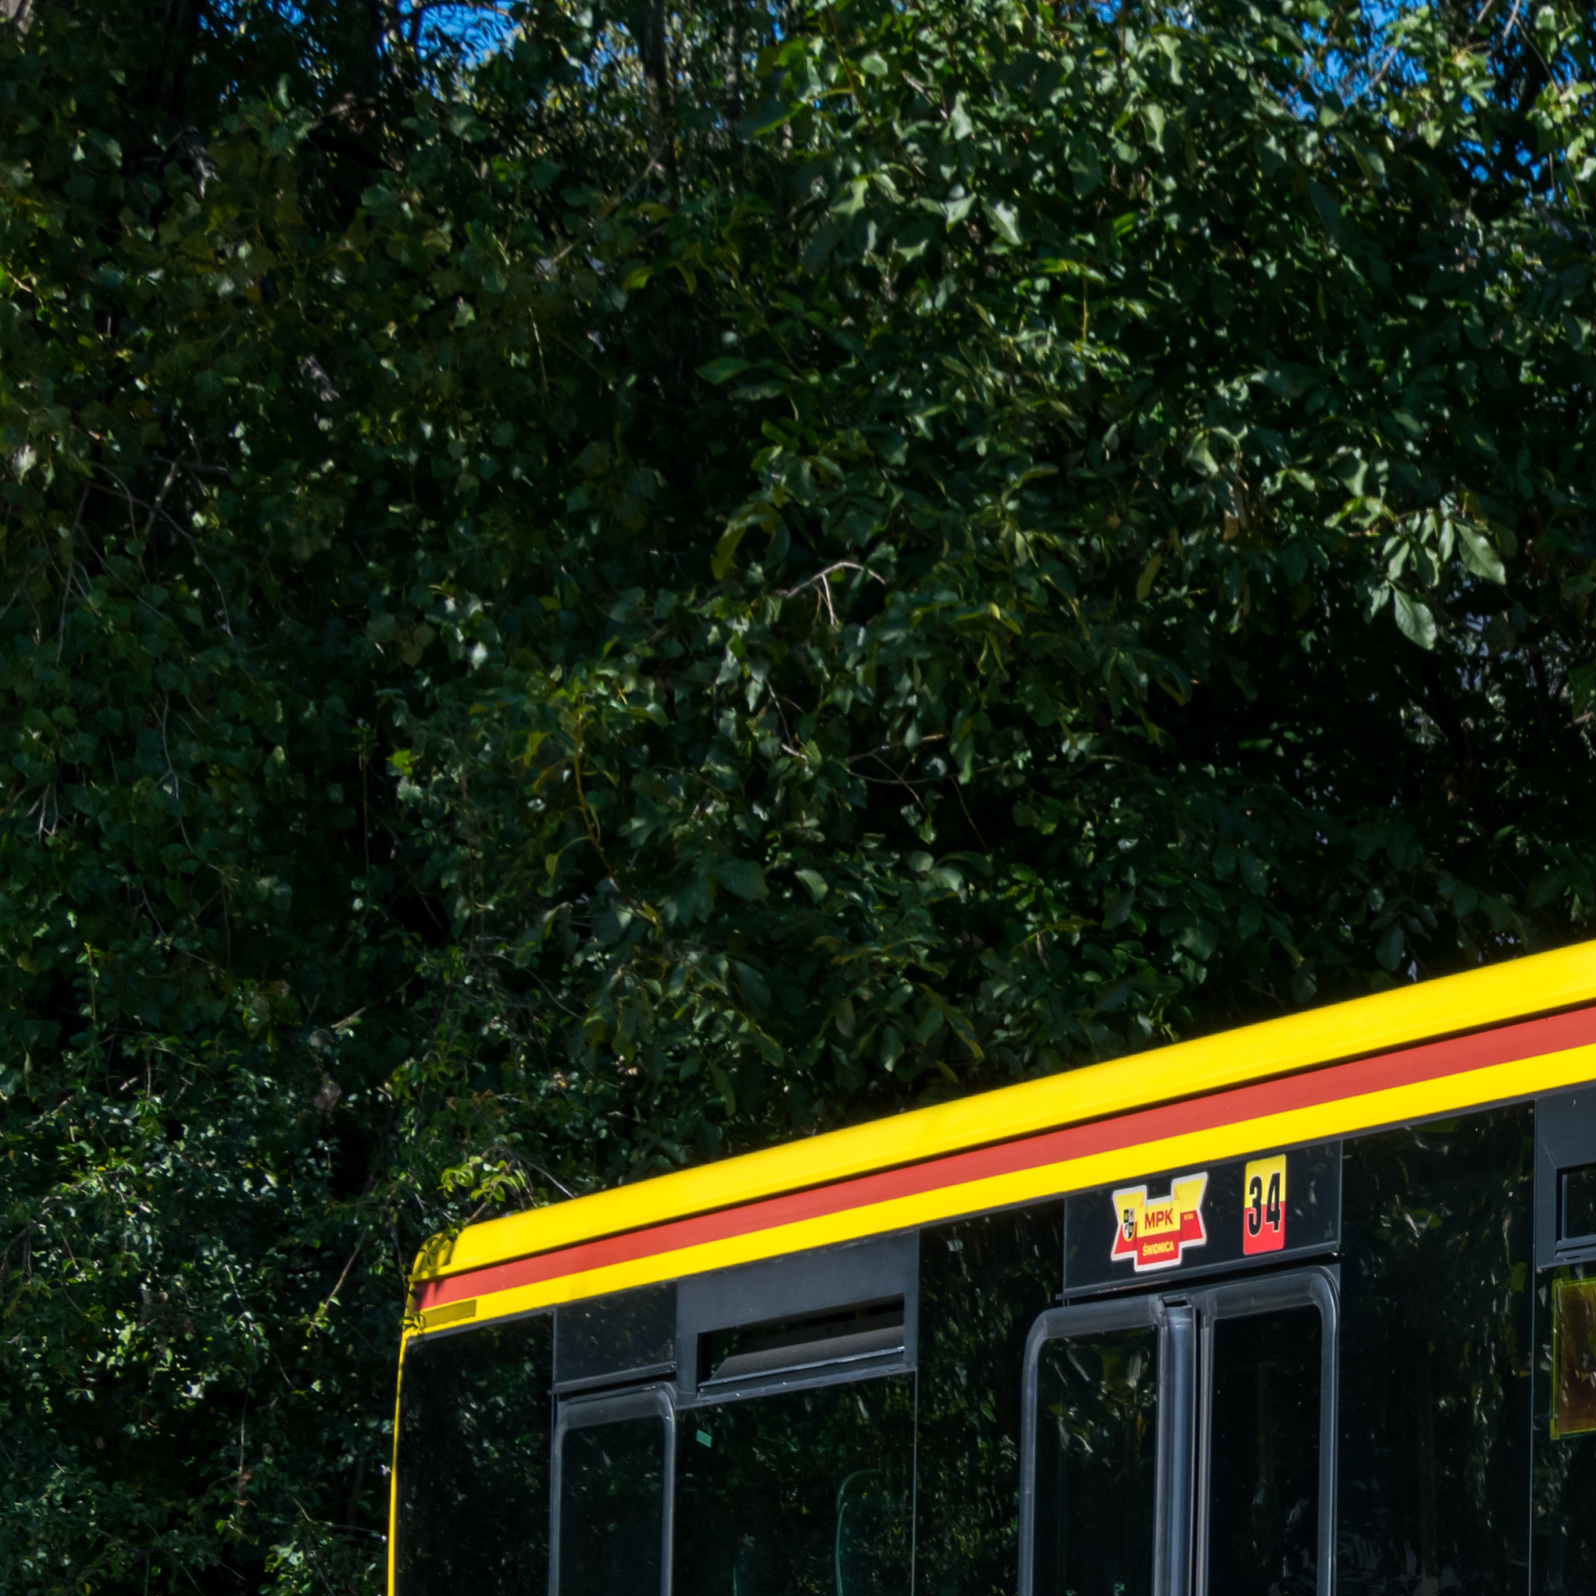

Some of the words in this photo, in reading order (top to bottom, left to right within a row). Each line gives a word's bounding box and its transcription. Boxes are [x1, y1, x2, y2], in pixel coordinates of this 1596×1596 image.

[1248, 1172, 1281, 1237] 34
[1145, 1208, 1173, 1230] MPK
[1142, 1241, 1175, 1257] ŚWIDNICA
